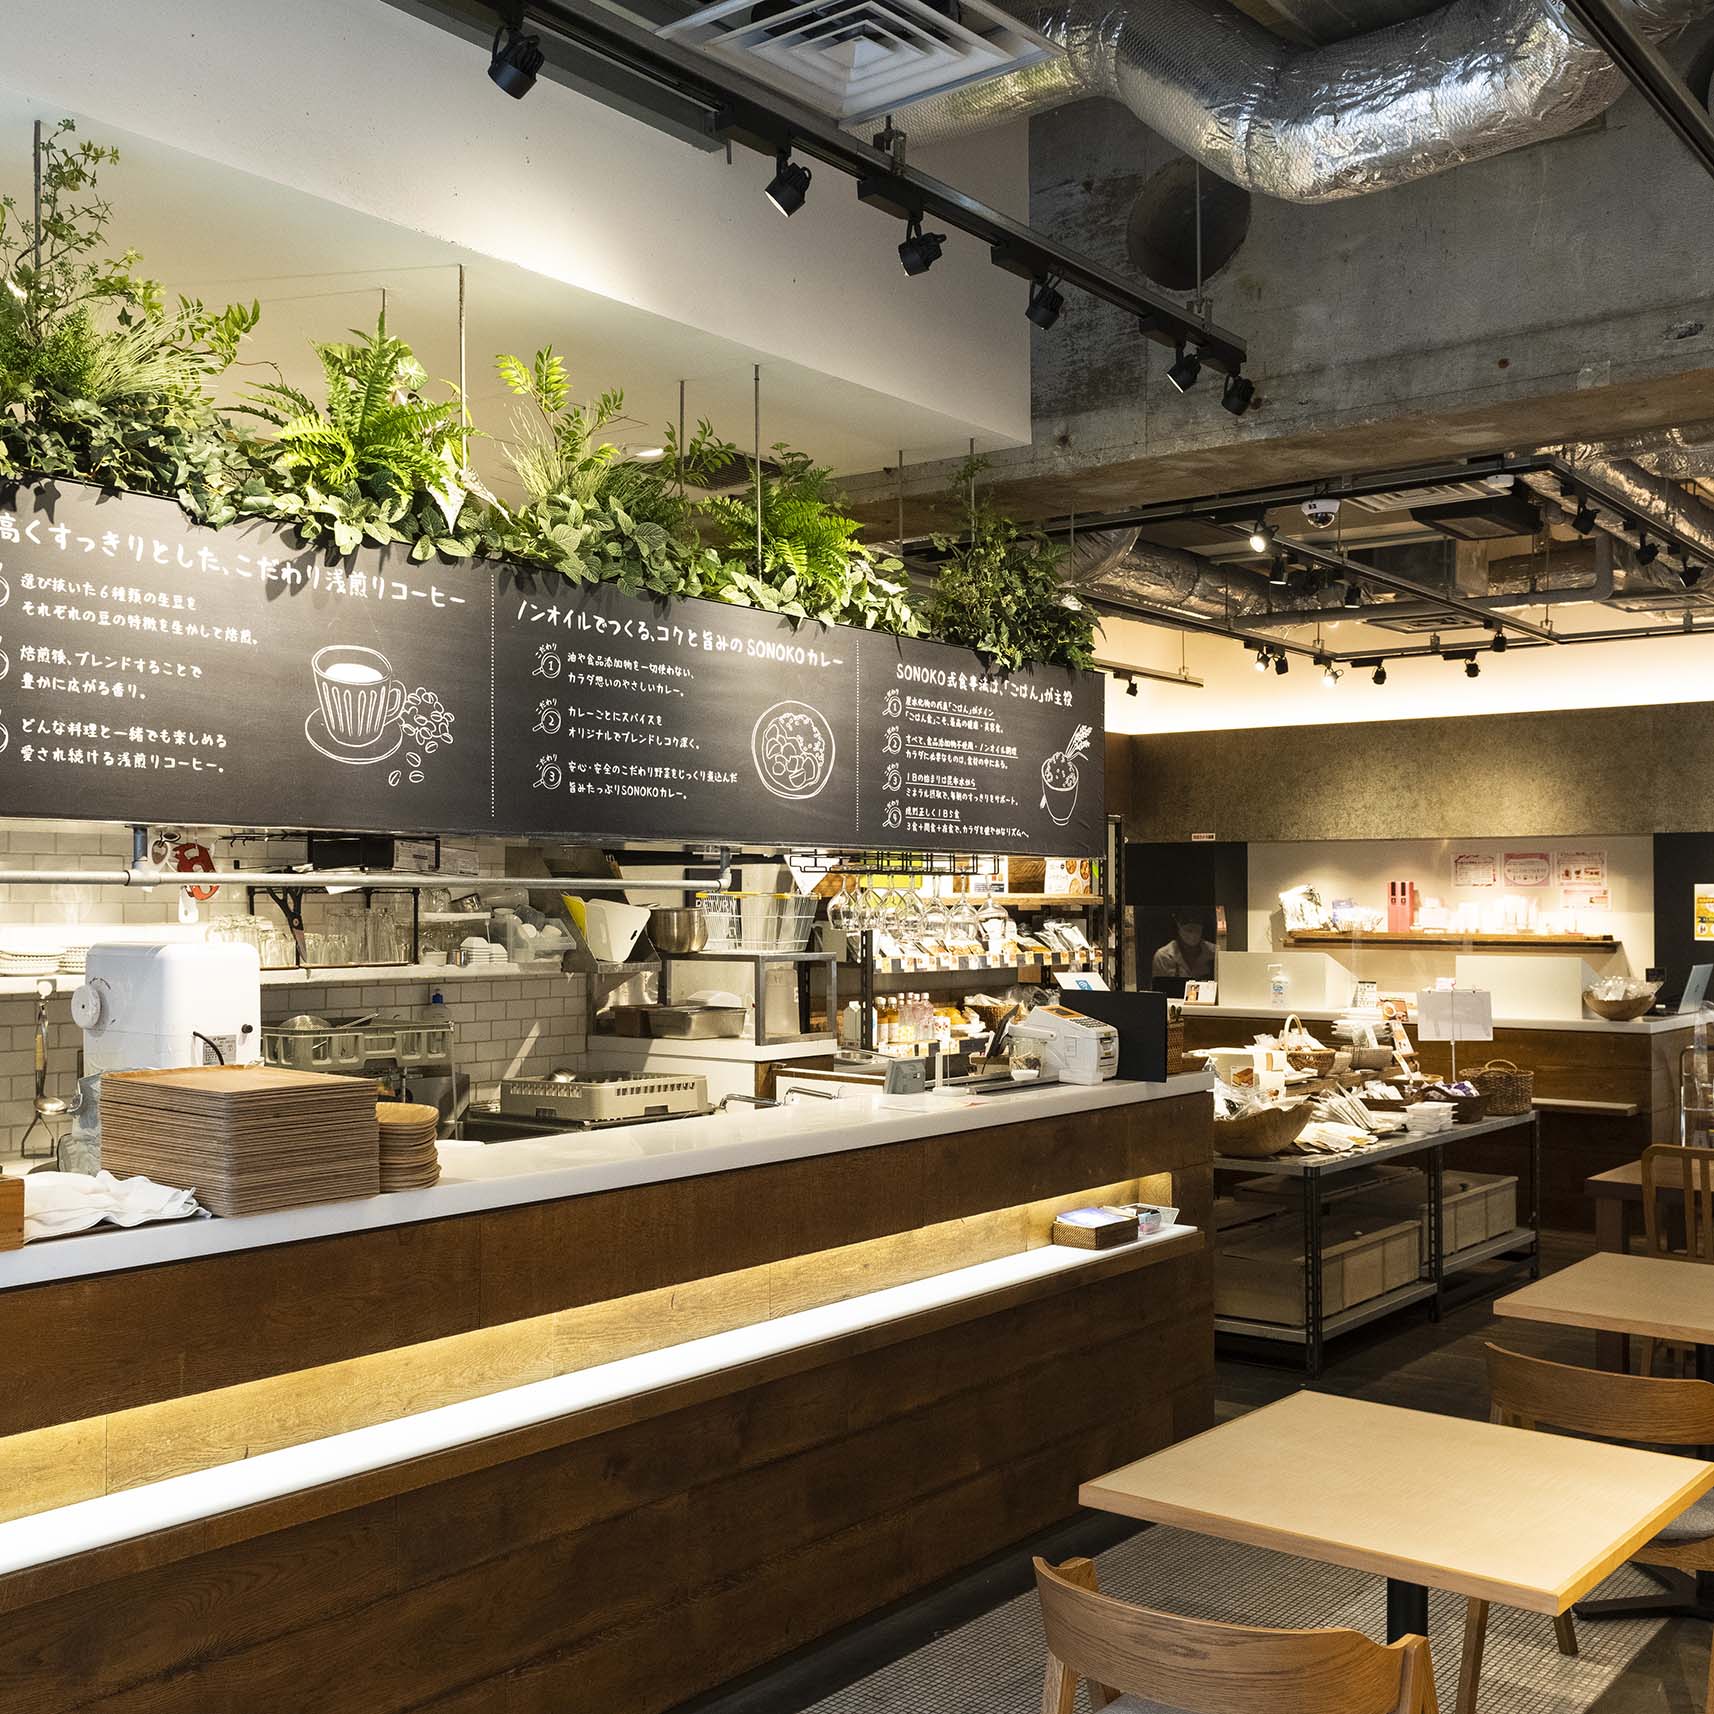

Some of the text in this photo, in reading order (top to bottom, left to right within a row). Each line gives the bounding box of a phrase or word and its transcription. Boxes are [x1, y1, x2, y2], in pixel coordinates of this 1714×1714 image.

[20, 573, 196, 611] 選び抜いた6種類の生豆を
[19, 645, 203, 679] 焙煎後、ブレンドすることで
[548, 661, 554, 671] 1
[20, 674, 146, 699] 豊かに広がる香り。
[548, 716, 555, 726] 2
[568, 707, 662, 726] カレーごとにスパイスを
[21, 718, 228, 748] どんな料理と一緒でも楽しめる
[549, 772, 555, 782] 3
